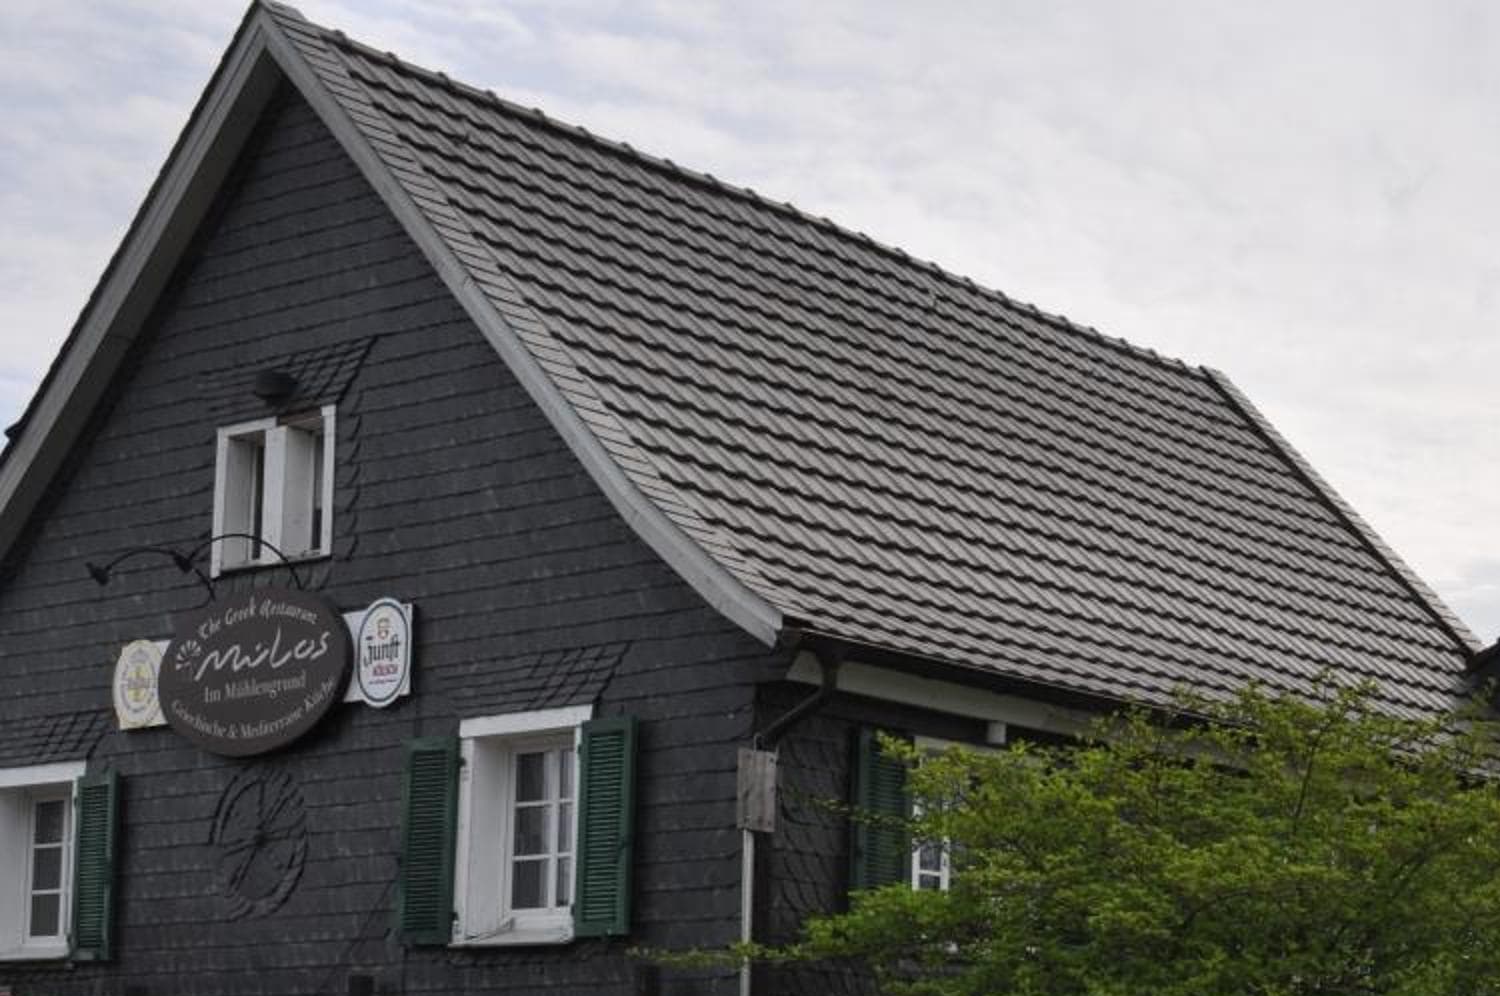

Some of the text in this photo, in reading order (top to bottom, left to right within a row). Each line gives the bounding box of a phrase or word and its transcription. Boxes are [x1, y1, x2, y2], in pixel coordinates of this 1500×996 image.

[198, 596, 318, 640] The Greek Restaurant
[204, 670, 306, 703] Im Mühlengrund
[227, 723, 239, 739] &
